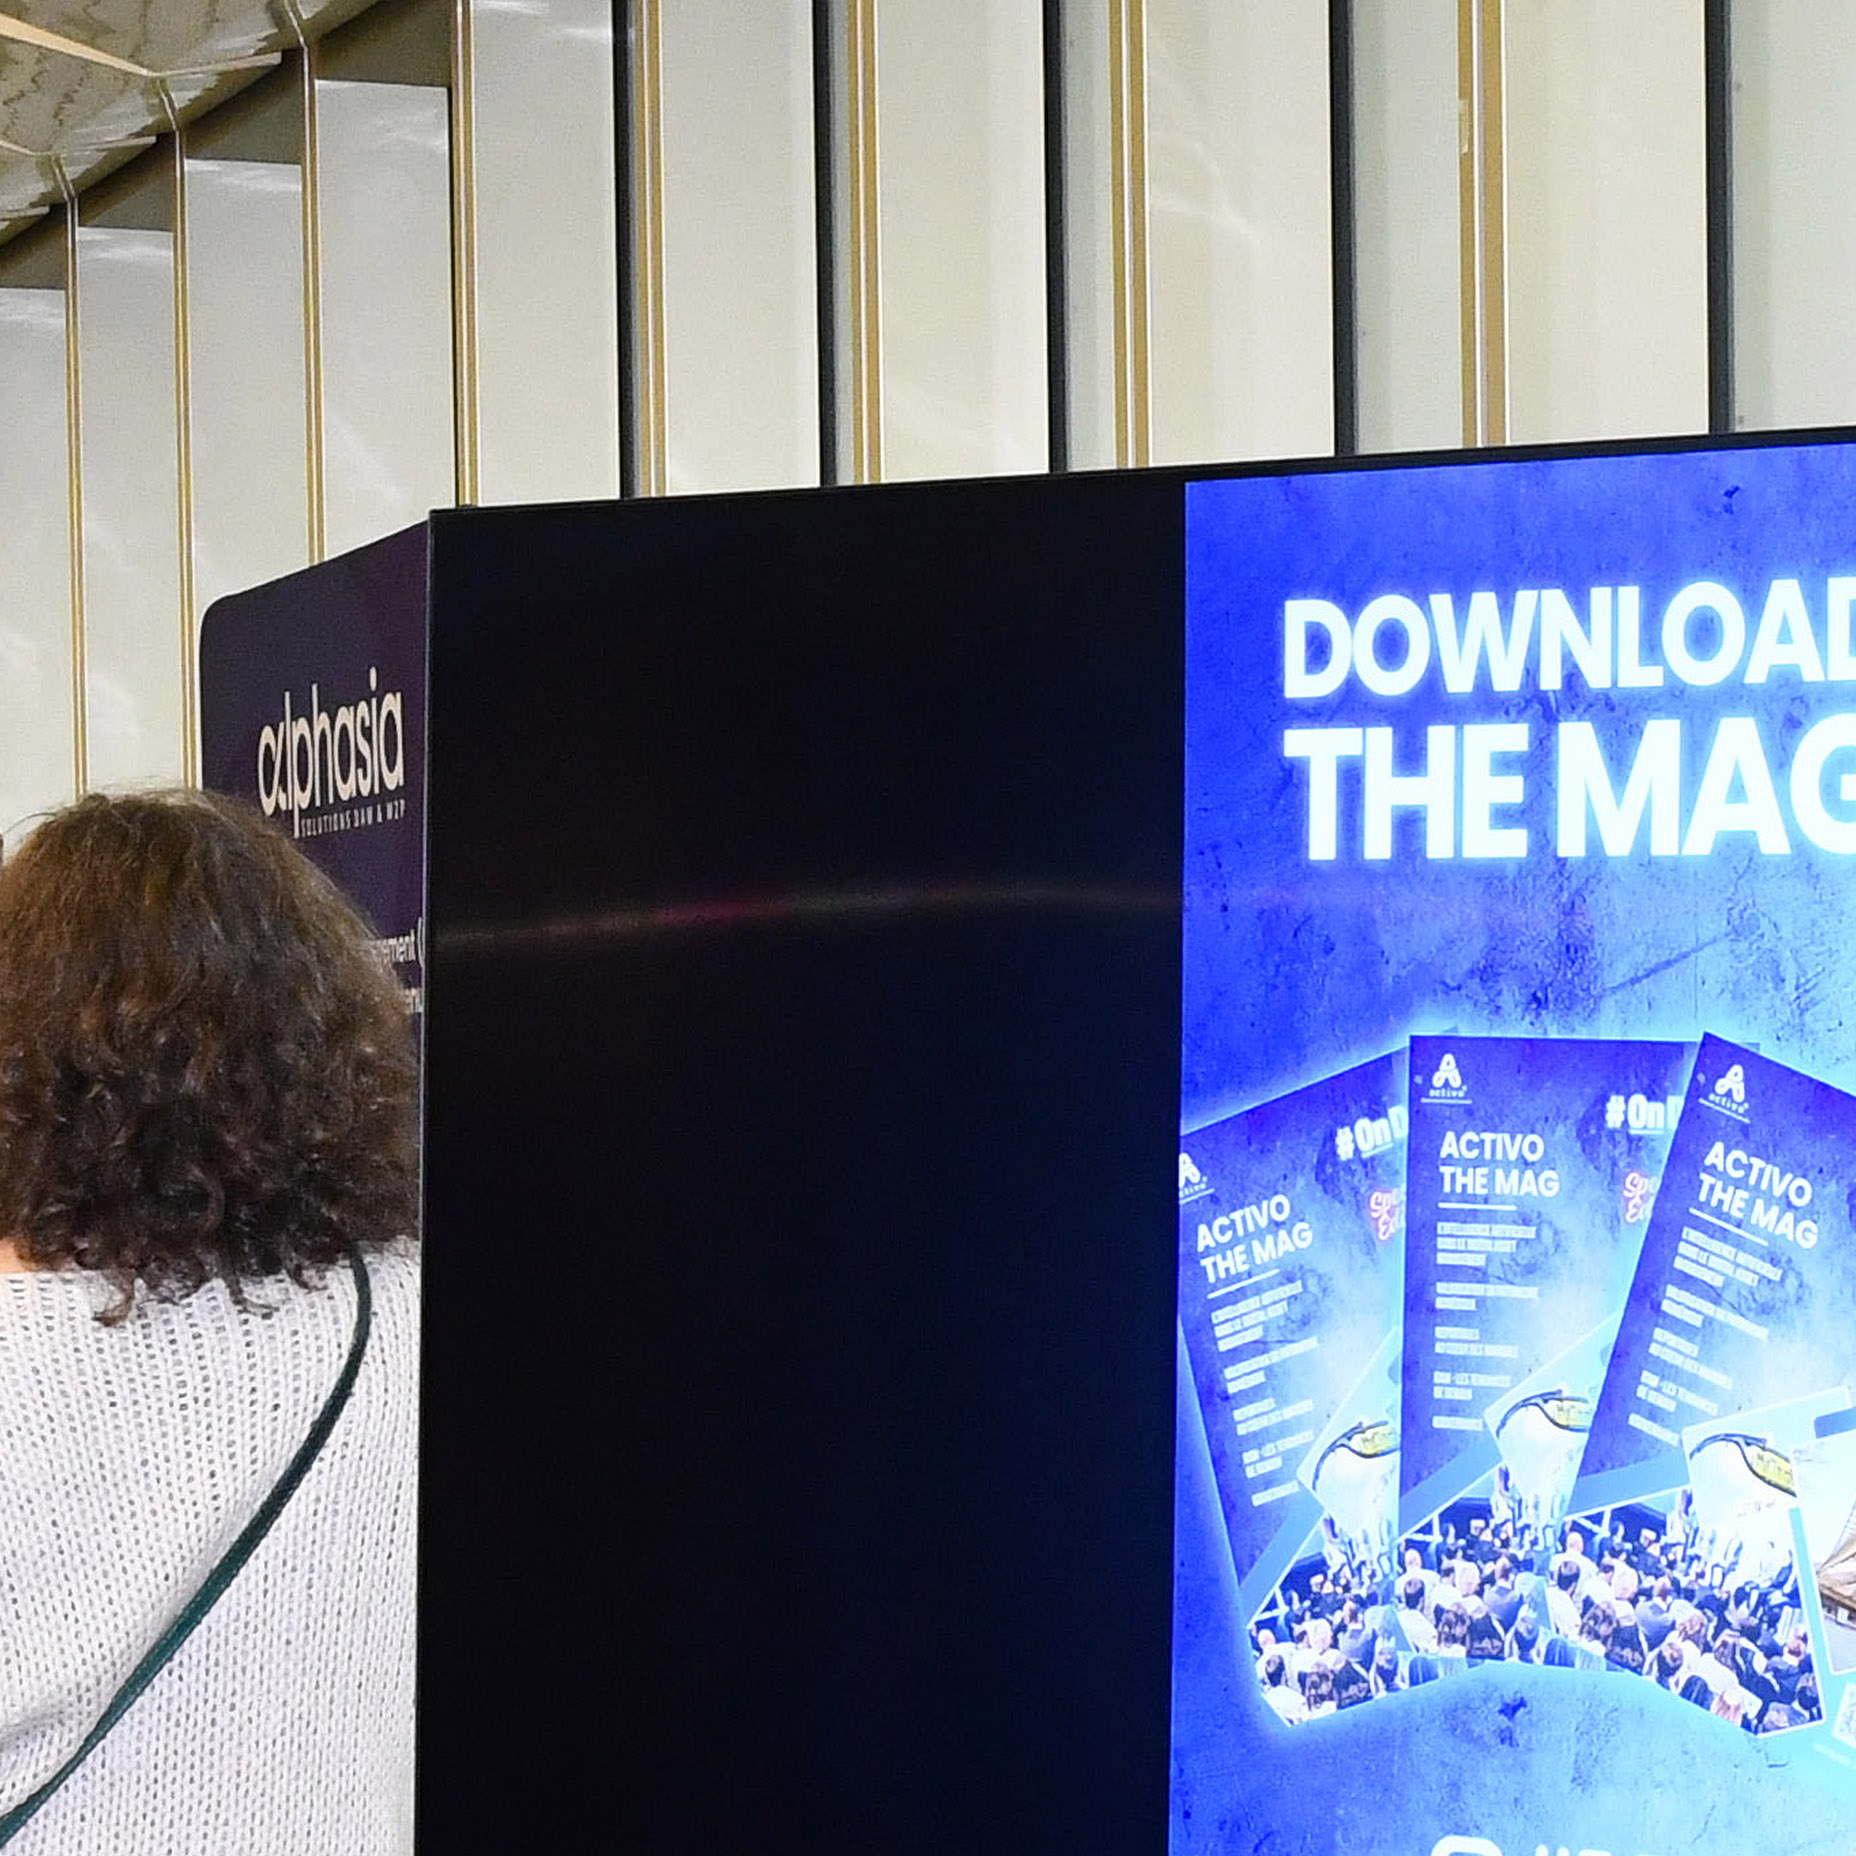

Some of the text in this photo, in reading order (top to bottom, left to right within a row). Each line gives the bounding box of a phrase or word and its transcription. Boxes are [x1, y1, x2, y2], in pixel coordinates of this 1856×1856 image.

[258, 666, 405, 839] alphasia
[1283, 722, 1529, 860] THE
[1440, 1131, 1544, 1162] ACTIVO
[1704, 1142, 1812, 1207] ACTIVO
[1439, 1166, 1560, 1197] THE MAG
[1699, 1173, 1749, 1218] THE
[1750, 1199, 1818, 1249] MAG
[1197, 1194, 1290, 1252] ACTIVO
[1200, 1222, 1313, 1283] THE MAG
